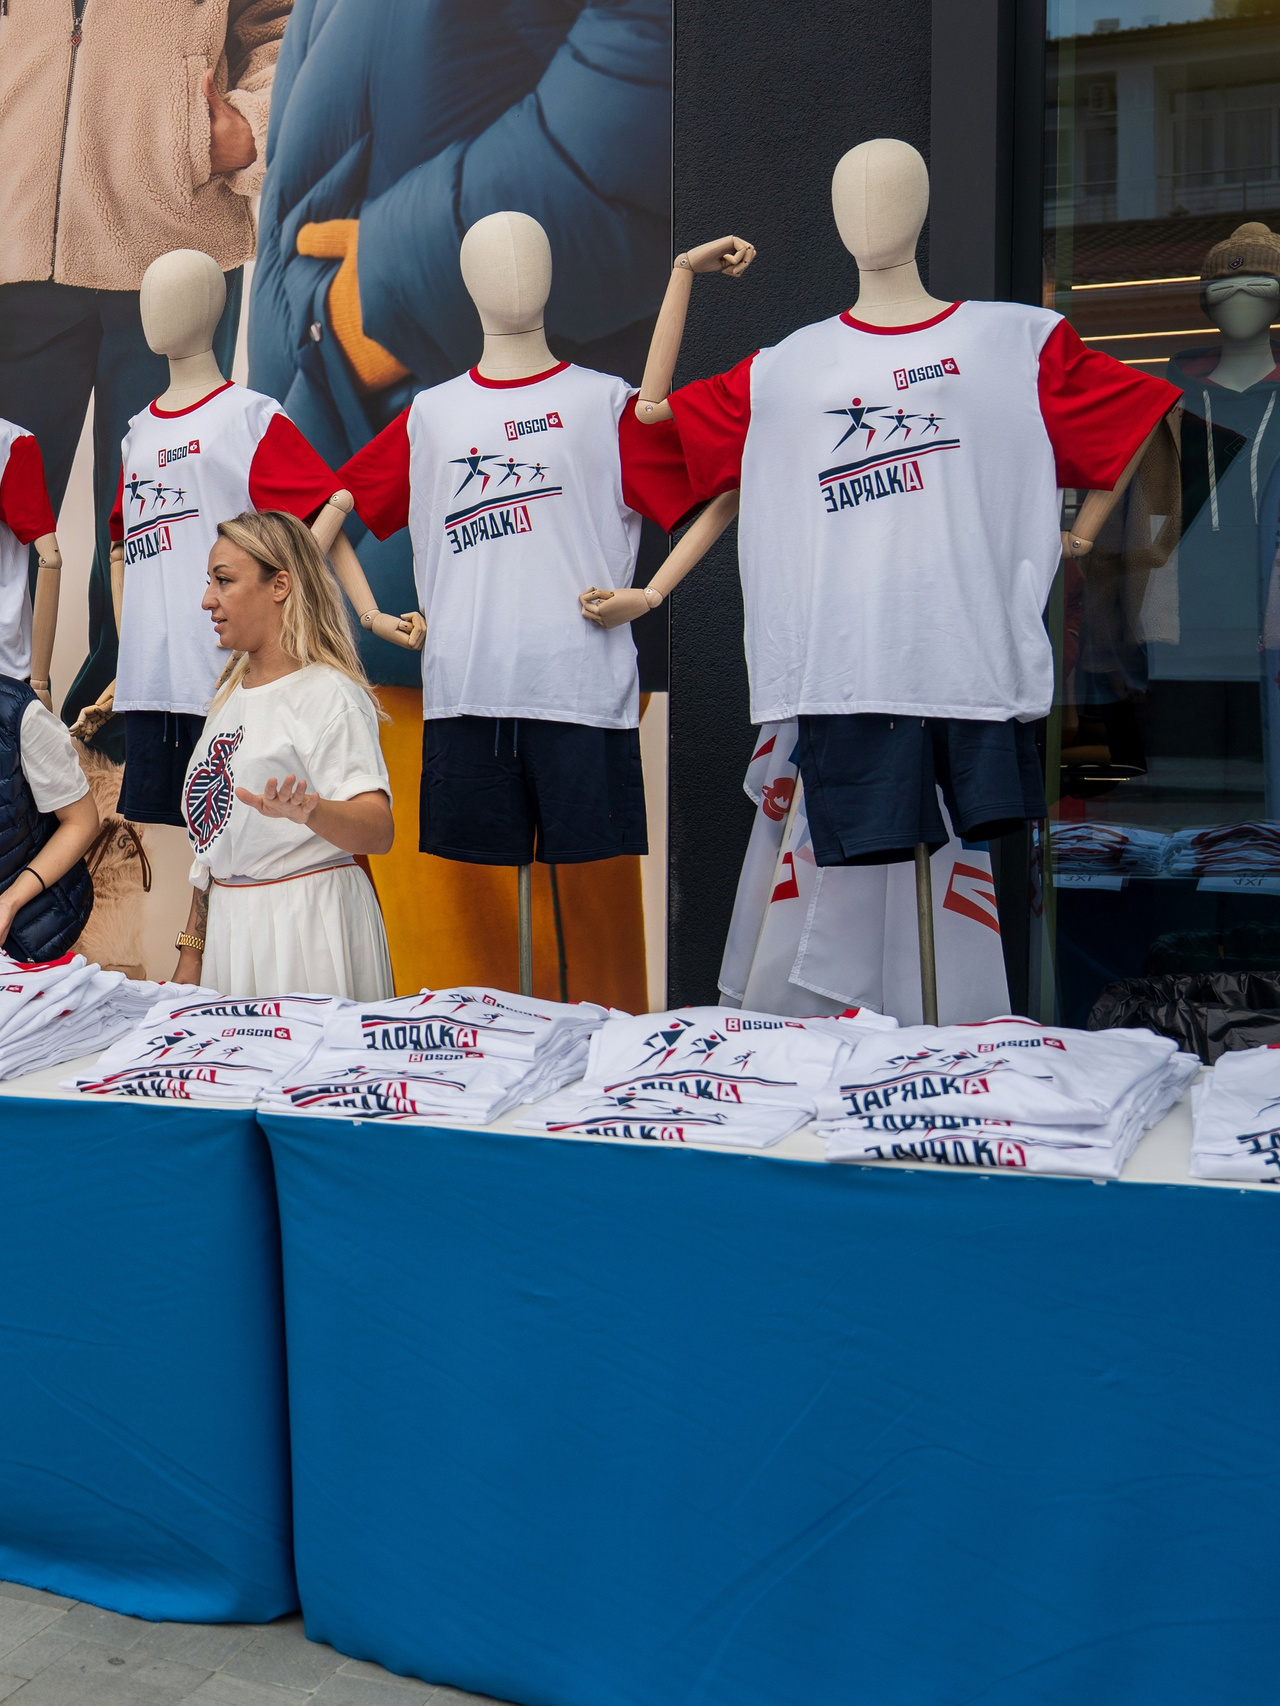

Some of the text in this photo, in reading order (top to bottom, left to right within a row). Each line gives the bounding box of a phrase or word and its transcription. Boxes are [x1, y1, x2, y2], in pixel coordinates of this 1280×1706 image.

[892, 363, 944, 391] BOSCO
[504, 417, 548, 441] BOSCO
[158, 445, 188, 467] BOSCO
[821, 460, 924, 513] ЗАРЯДКА
[446, 505, 532, 555] ЗАРЯДКА
